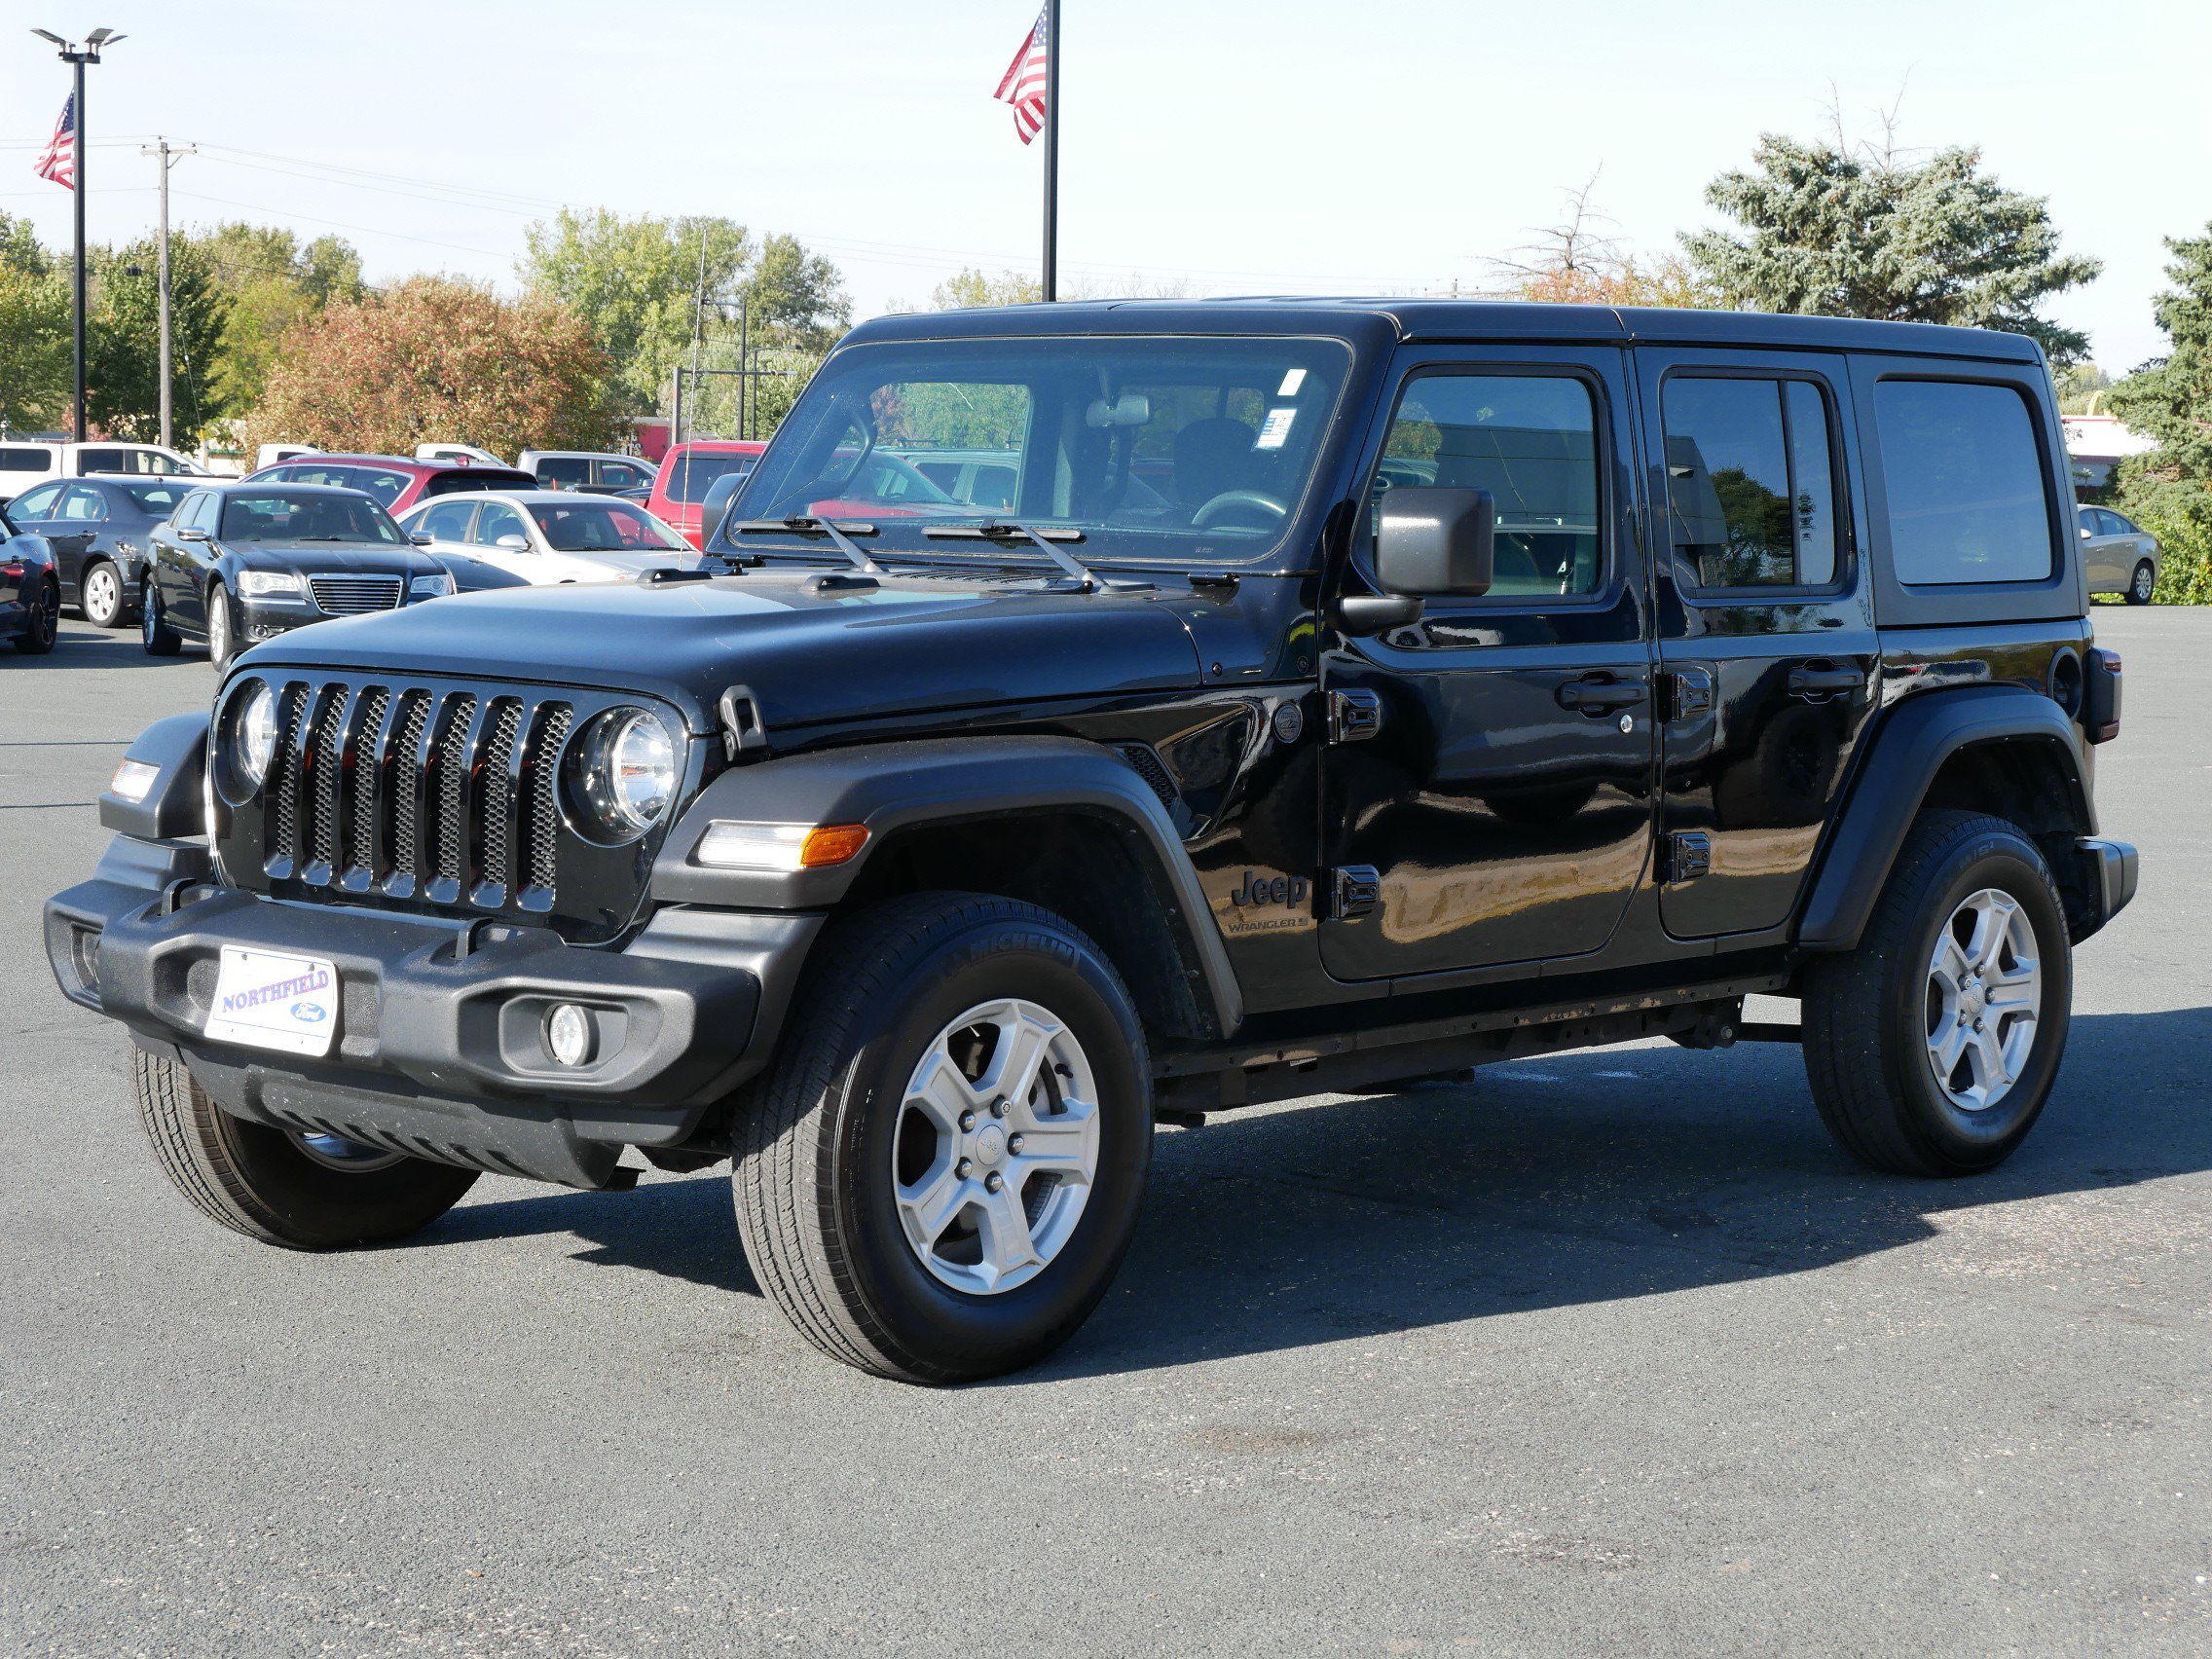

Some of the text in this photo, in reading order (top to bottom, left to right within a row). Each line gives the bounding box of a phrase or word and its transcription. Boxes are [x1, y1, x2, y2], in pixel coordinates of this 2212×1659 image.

[1231, 870, 1308, 909] Jeep
[1228, 918, 1296, 933] WRANGLER
[971, 932, 1075, 967] MICHELIN
[221, 970, 329, 1014] NORTHFIELD
